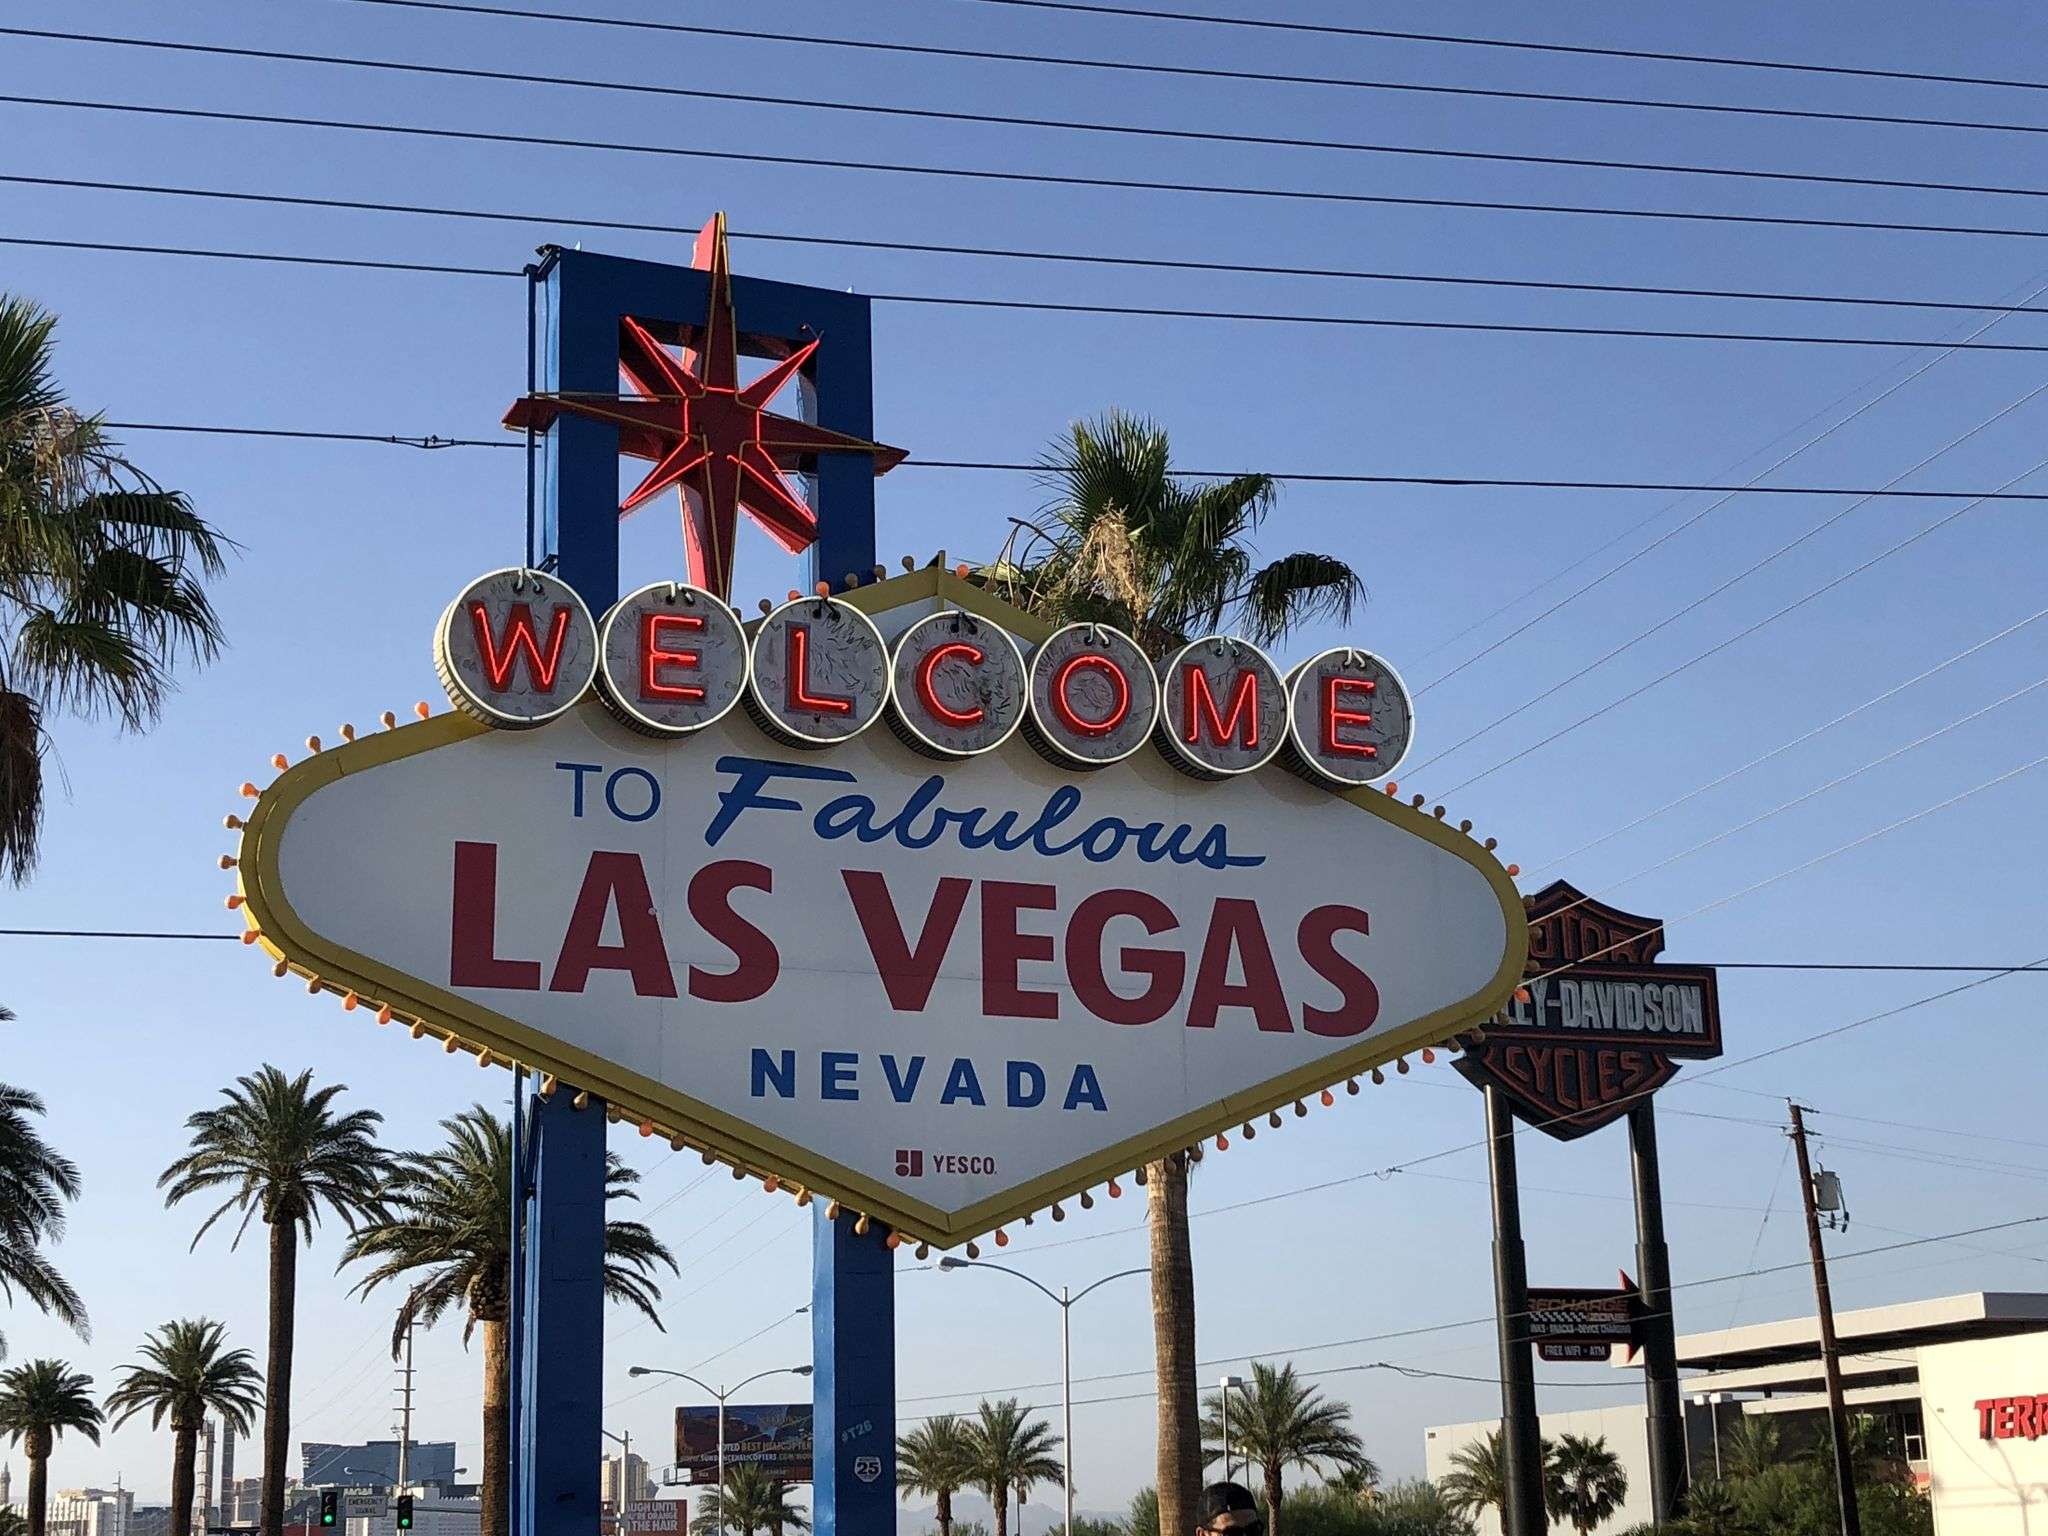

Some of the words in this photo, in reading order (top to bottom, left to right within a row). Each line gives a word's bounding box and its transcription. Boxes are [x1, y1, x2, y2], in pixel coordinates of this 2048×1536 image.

[467, 600, 1377, 760] WELCOME
[555, 761, 661, 822] TO
[704, 755, 1266, 869] Fabulous
[450, 840, 780, 1003] LAS
[841, 869, 1380, 1038] VEGAS
[1490, 979, 1705, 1034] LEY-DAVIDSON
[750, 1048, 1108, 1112] NEVADA
[1506, 1046, 1643, 1110] CYCLES
[1544, 1345, 1563, 1356] FREE
[1589, 1345, 1606, 1356] ATM
[856, 1462, 880, 1475] 25
[632, 1520, 651, 1532] THE
[652, 1519, 678, 1532] HAIR
